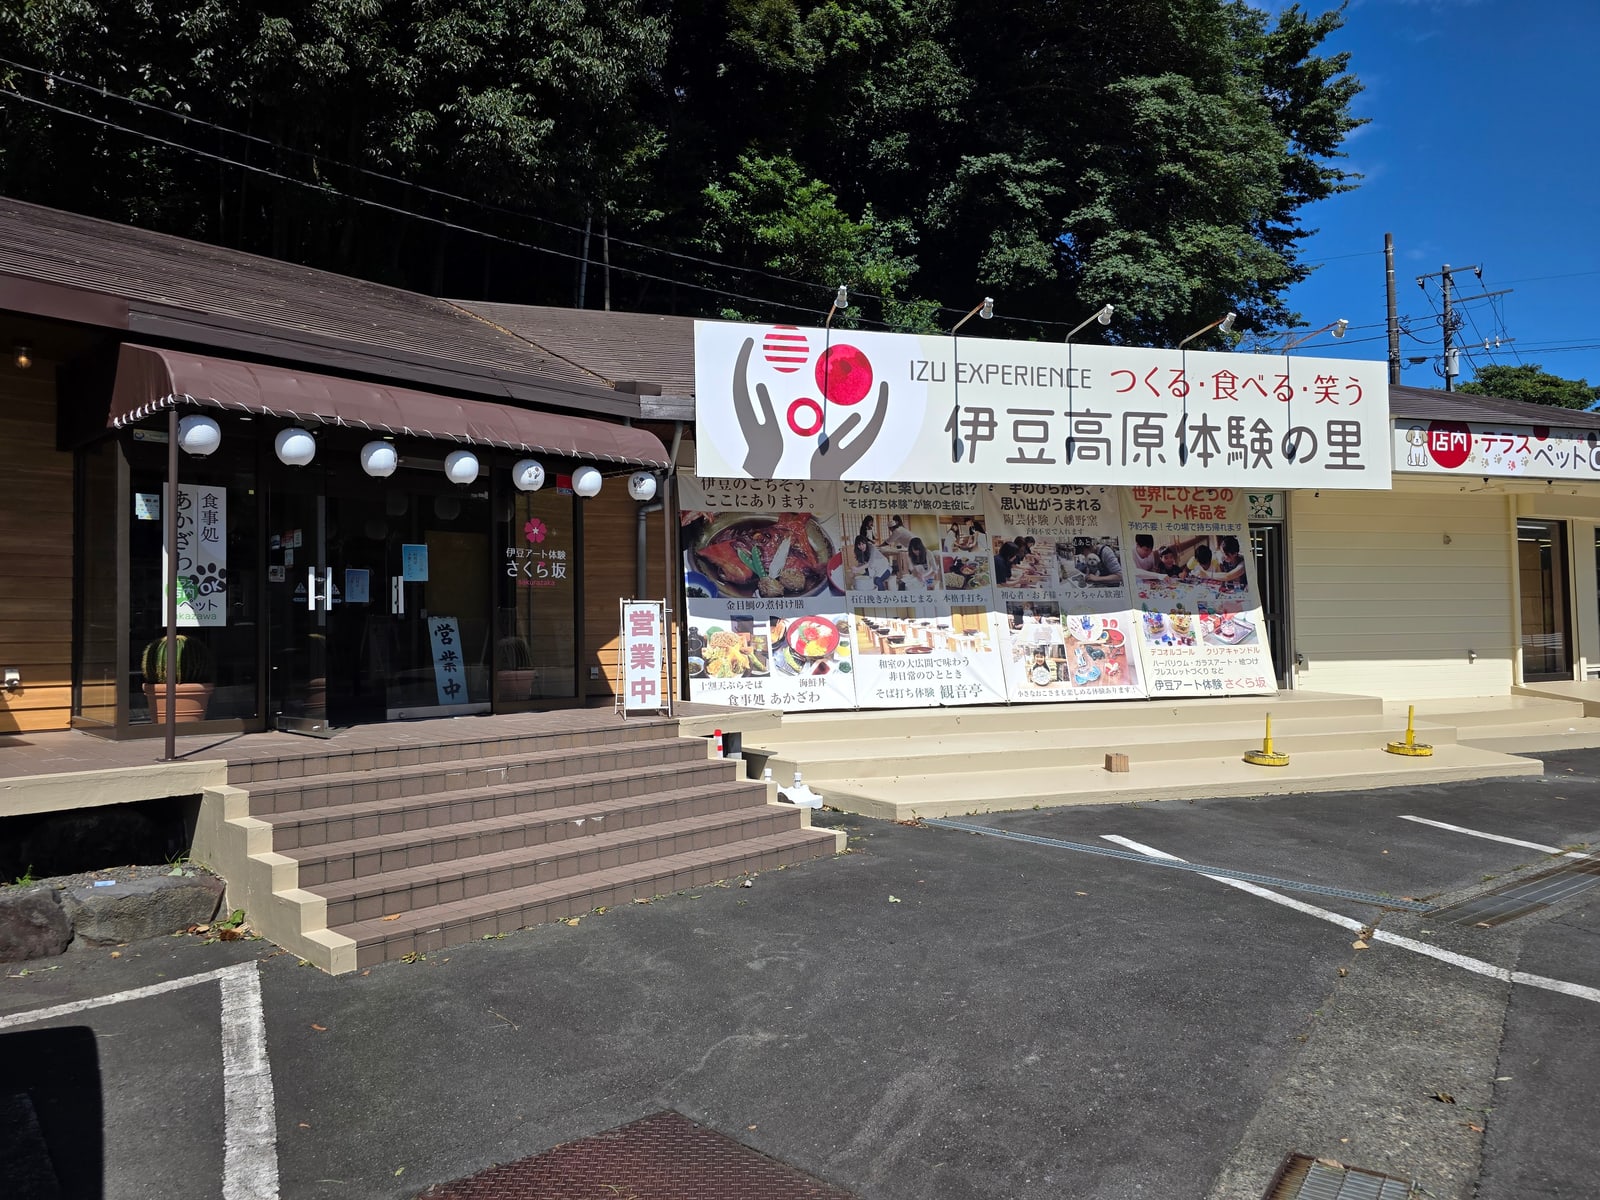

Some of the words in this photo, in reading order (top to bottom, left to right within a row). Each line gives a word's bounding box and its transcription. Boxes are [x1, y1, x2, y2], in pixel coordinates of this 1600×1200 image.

[909, 359, 947, 383] IZU
[956, 362, 1092, 390] EXPERIENCE
[944, 405, 1366, 471] 伊豆高原体験の里
[1533, 444, 1587, 470] ペット
[705, 493, 816, 509] ここにあります。
[1131, 486, 1234, 503] 世界にひとつの
[1000, 496, 1102, 512] 思い出がうまれる
[1139, 503, 1227, 521] アート作品を
[201, 492, 219, 543] 食事処
[505, 547, 567, 560] 伊豆アート体験
[505, 560, 567, 579] さくら坂
[179, 597, 219, 612] ペット
[177, 612, 218, 621] kazawa
[433, 623, 462, 700] 営業中
[629, 610, 656, 704] 営業中
[879, 656, 970, 669] 和室の大広間で味わう
[799, 677, 827, 688] 海鮮丼
[888, 669, 963, 682] 非日常のひととき
[1155, 679, 1224, 691] 伊豆アート体験
[1224, 676, 1267, 690] さくら坂
[728, 692, 766, 707] 食事処
[770, 690, 822, 705] あかざわ
[875, 687, 936, 700] そば打ち体験
[939, 683, 984, 700] 観音亭
